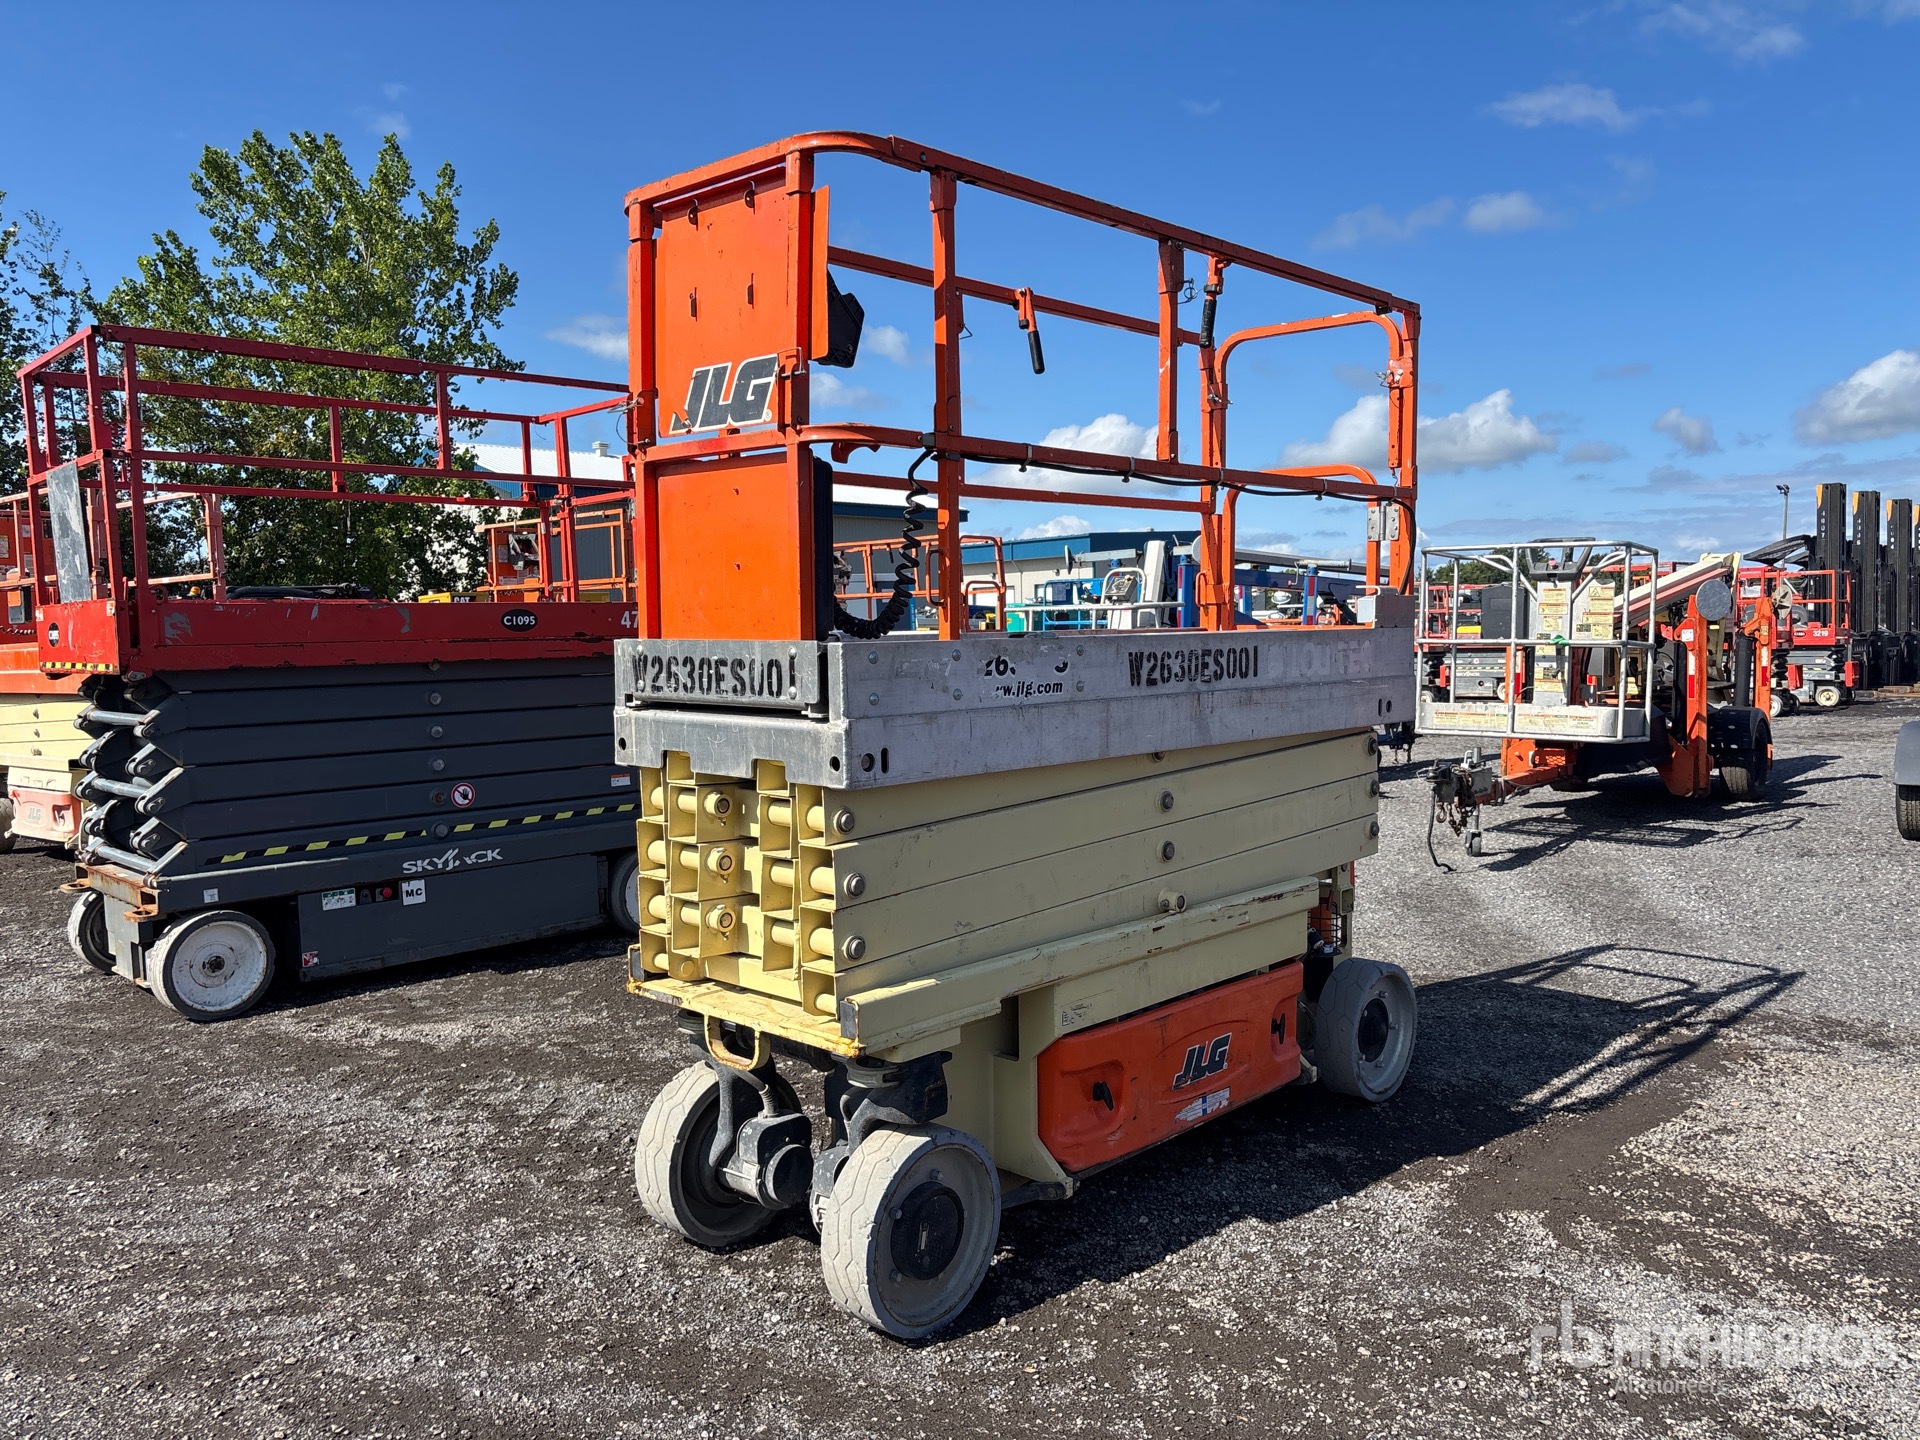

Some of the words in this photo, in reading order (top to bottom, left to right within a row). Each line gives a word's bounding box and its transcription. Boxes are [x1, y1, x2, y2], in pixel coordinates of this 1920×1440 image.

[669, 354, 779, 434] JLG
[503, 615, 536, 627] C1095
[1172, 1032, 1232, 1090] JLG
